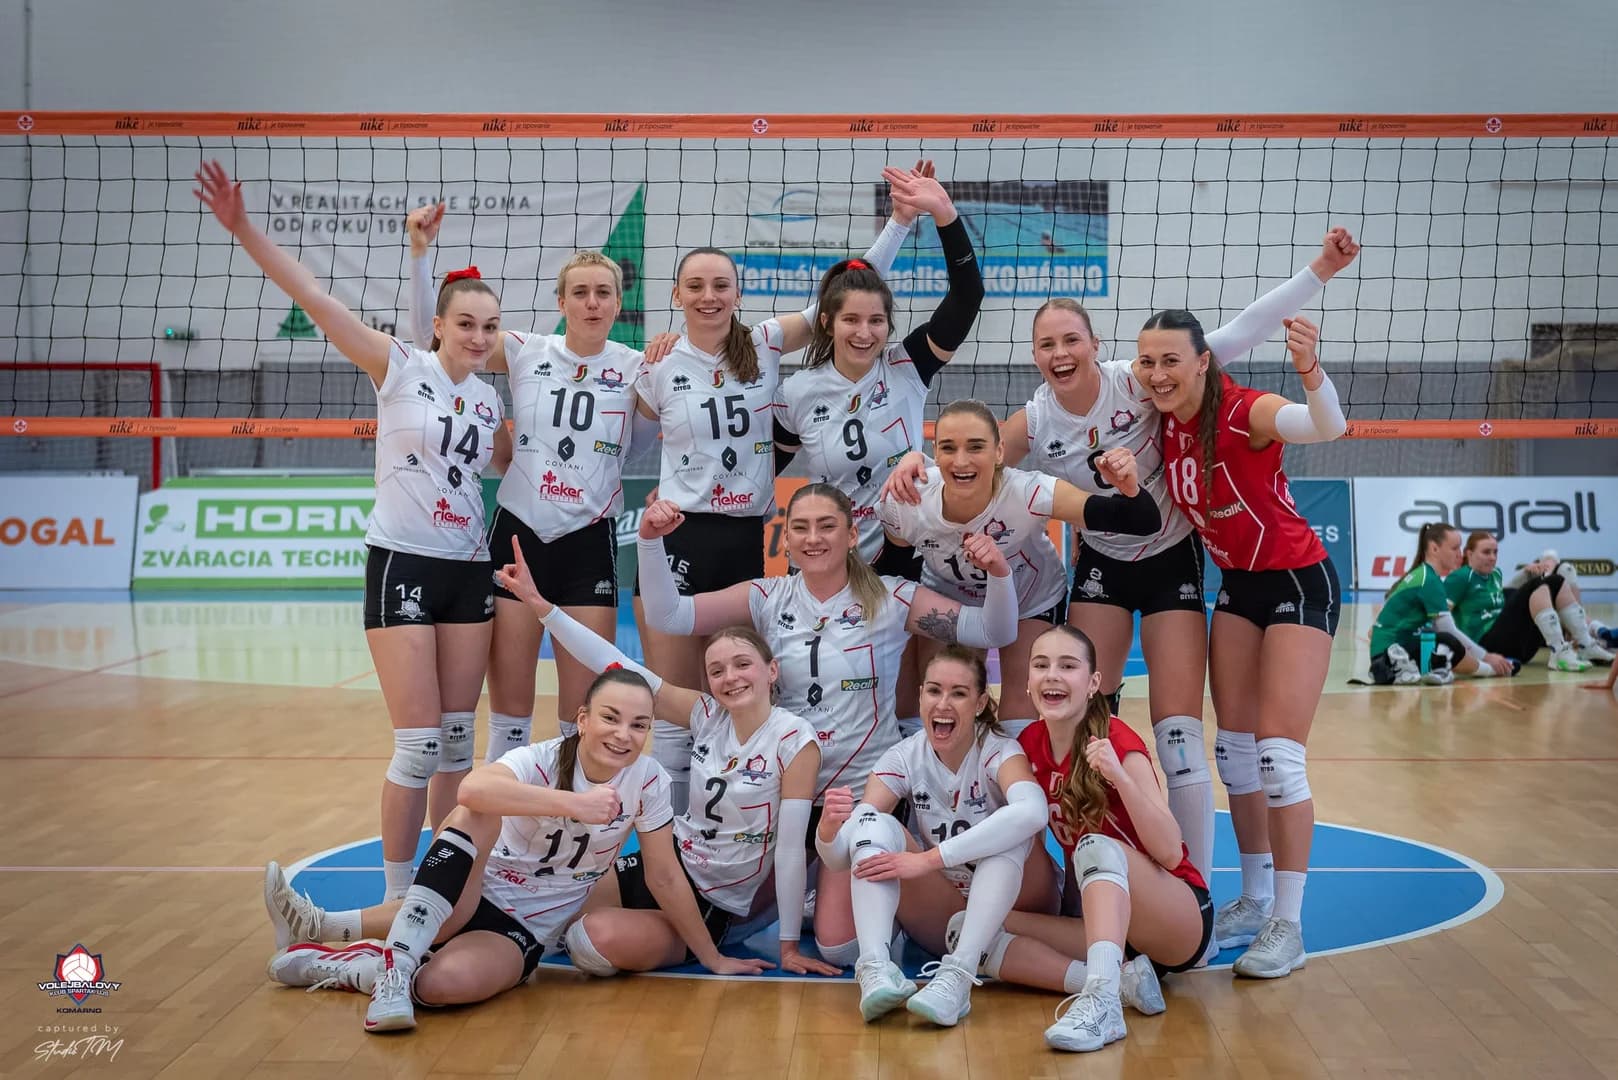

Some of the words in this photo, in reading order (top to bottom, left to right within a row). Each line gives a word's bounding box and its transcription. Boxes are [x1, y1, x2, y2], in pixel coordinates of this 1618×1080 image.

[469, 196, 530, 210] DOMA
[273, 217, 301, 232] OD
[312, 218, 368, 233] ROKU
[984, 261, 1103, 292] KOMÁRNO
[550, 387, 595, 432] 10
[701, 394, 750, 440] 15
[109, 420, 133, 434] niké
[231, 421, 256, 435] niké
[438, 415, 480, 465] 14
[842, 418, 868, 461] 9
[1575, 421, 1599, 435] niké
[540, 482, 584, 498] rieker
[1169, 457, 1199, 505] 18
[710, 492, 754, 507] rieker
[0, 517, 115, 546] OGAL
[433, 509, 471, 527] rieker
[1398, 491, 1600, 543] agrall
[141, 547, 273, 568] ZVÁRACIA
[395, 583, 422, 602] 14
[804, 635, 821, 678] 1
[705, 777, 728, 823] 2
[539, 828, 591, 870] 11
